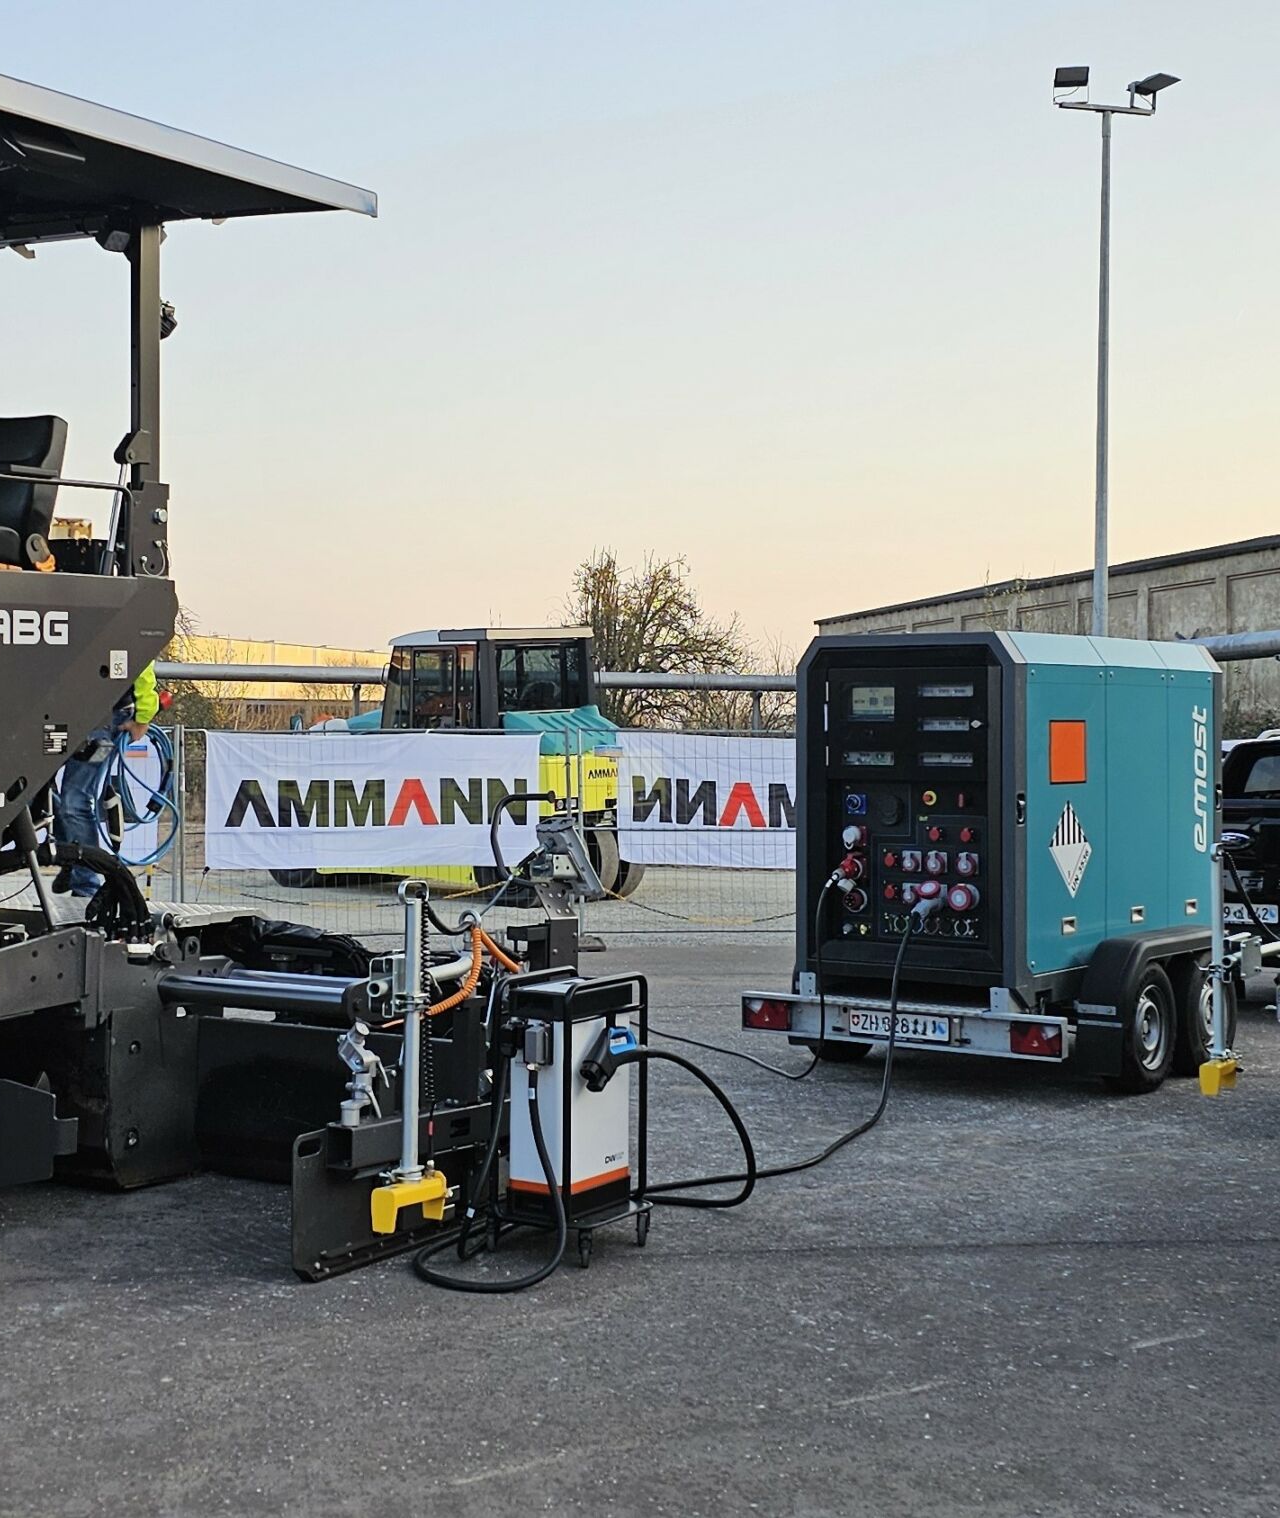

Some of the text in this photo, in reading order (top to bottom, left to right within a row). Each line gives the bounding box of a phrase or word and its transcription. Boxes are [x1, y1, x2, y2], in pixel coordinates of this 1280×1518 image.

[588, 768, 618, 779] AMMA
[1192, 705, 1207, 853] emost
[225, 778, 527, 827] AMMANN
